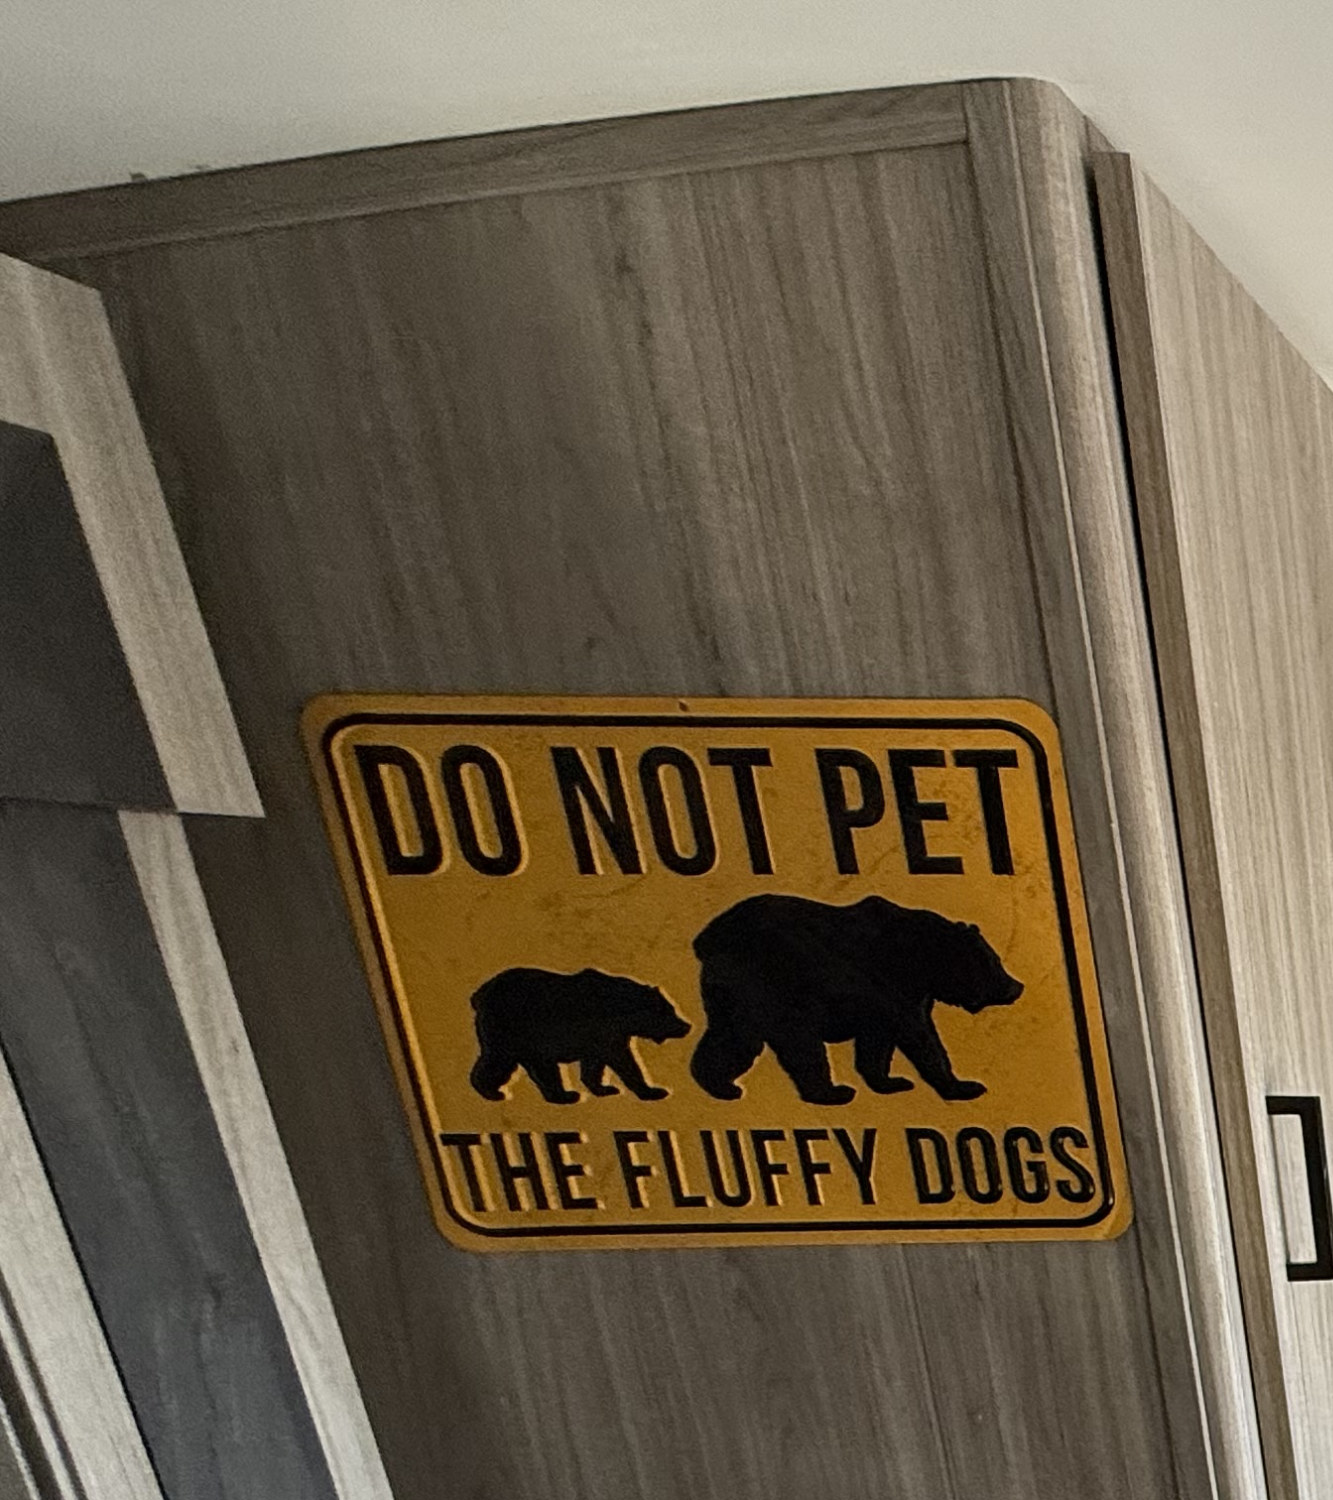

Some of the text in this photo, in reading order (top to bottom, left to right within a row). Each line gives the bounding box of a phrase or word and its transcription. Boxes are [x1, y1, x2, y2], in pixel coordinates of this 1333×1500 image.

[352, 743, 1019, 877] DO NOT PET
[438, 1125, 1097, 1214] THE FLUFFY DOGS
